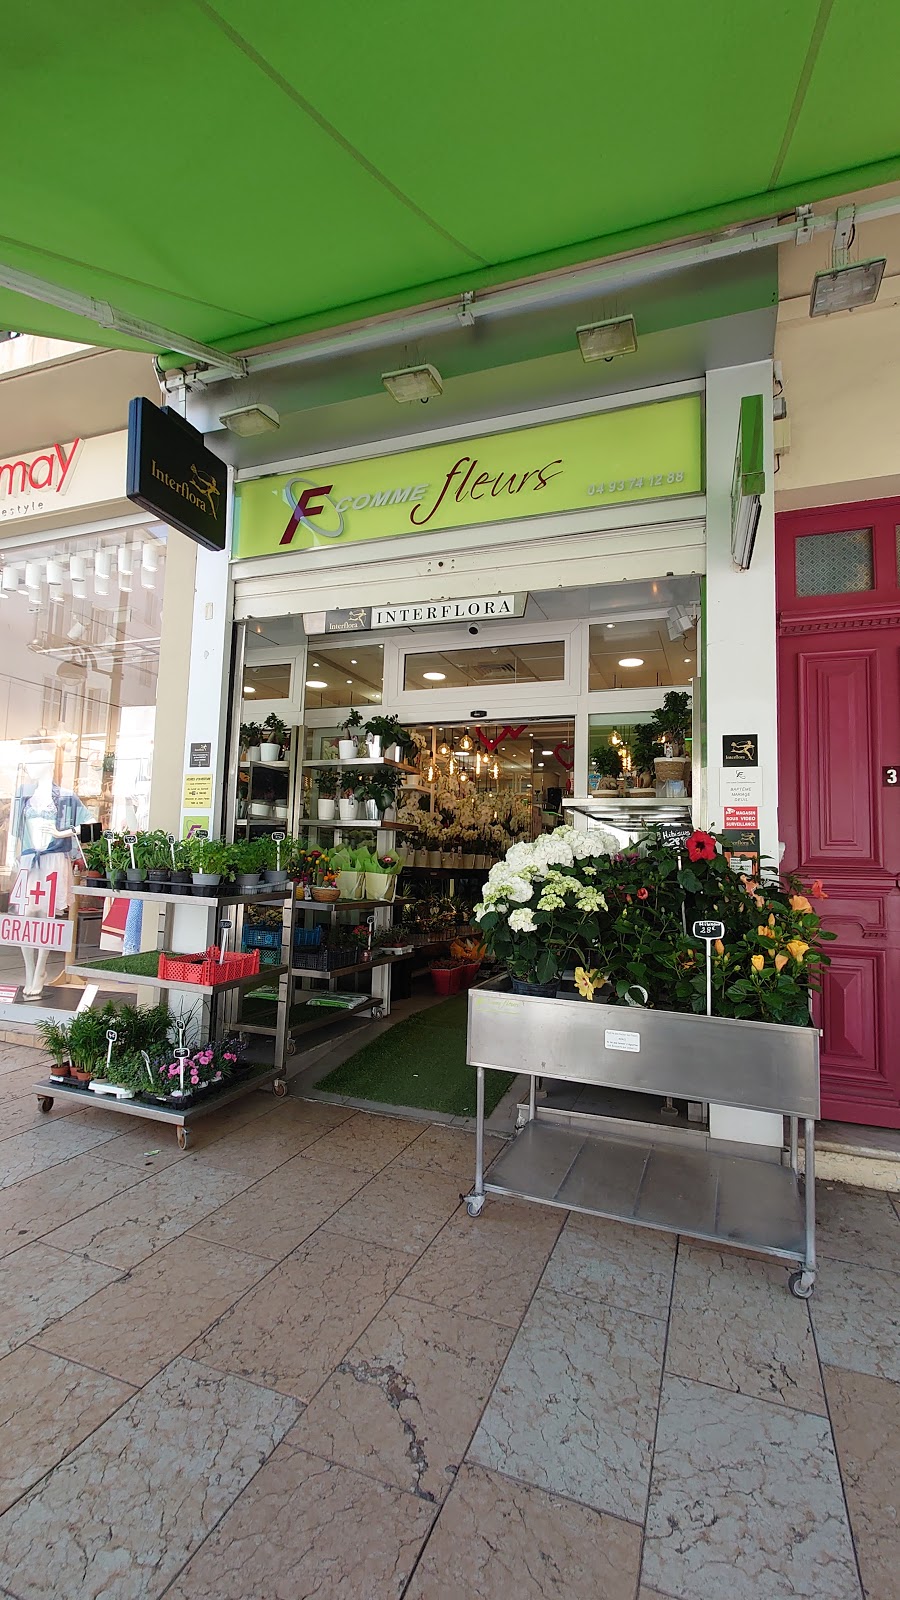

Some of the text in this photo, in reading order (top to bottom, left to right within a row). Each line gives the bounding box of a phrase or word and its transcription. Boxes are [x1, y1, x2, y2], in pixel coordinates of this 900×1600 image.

[151, 459, 207, 513] Interflora
[587, 471, 685, 496] 04 93 74 12 88
[279, 456, 564, 545] F COMME fleurs
[377, 600, 511, 623] INTERFLORA
[329, 621, 359, 630] Interflora
[886, 769, 898, 784] 3
[1, 918, 66, 946] GRATUIT
